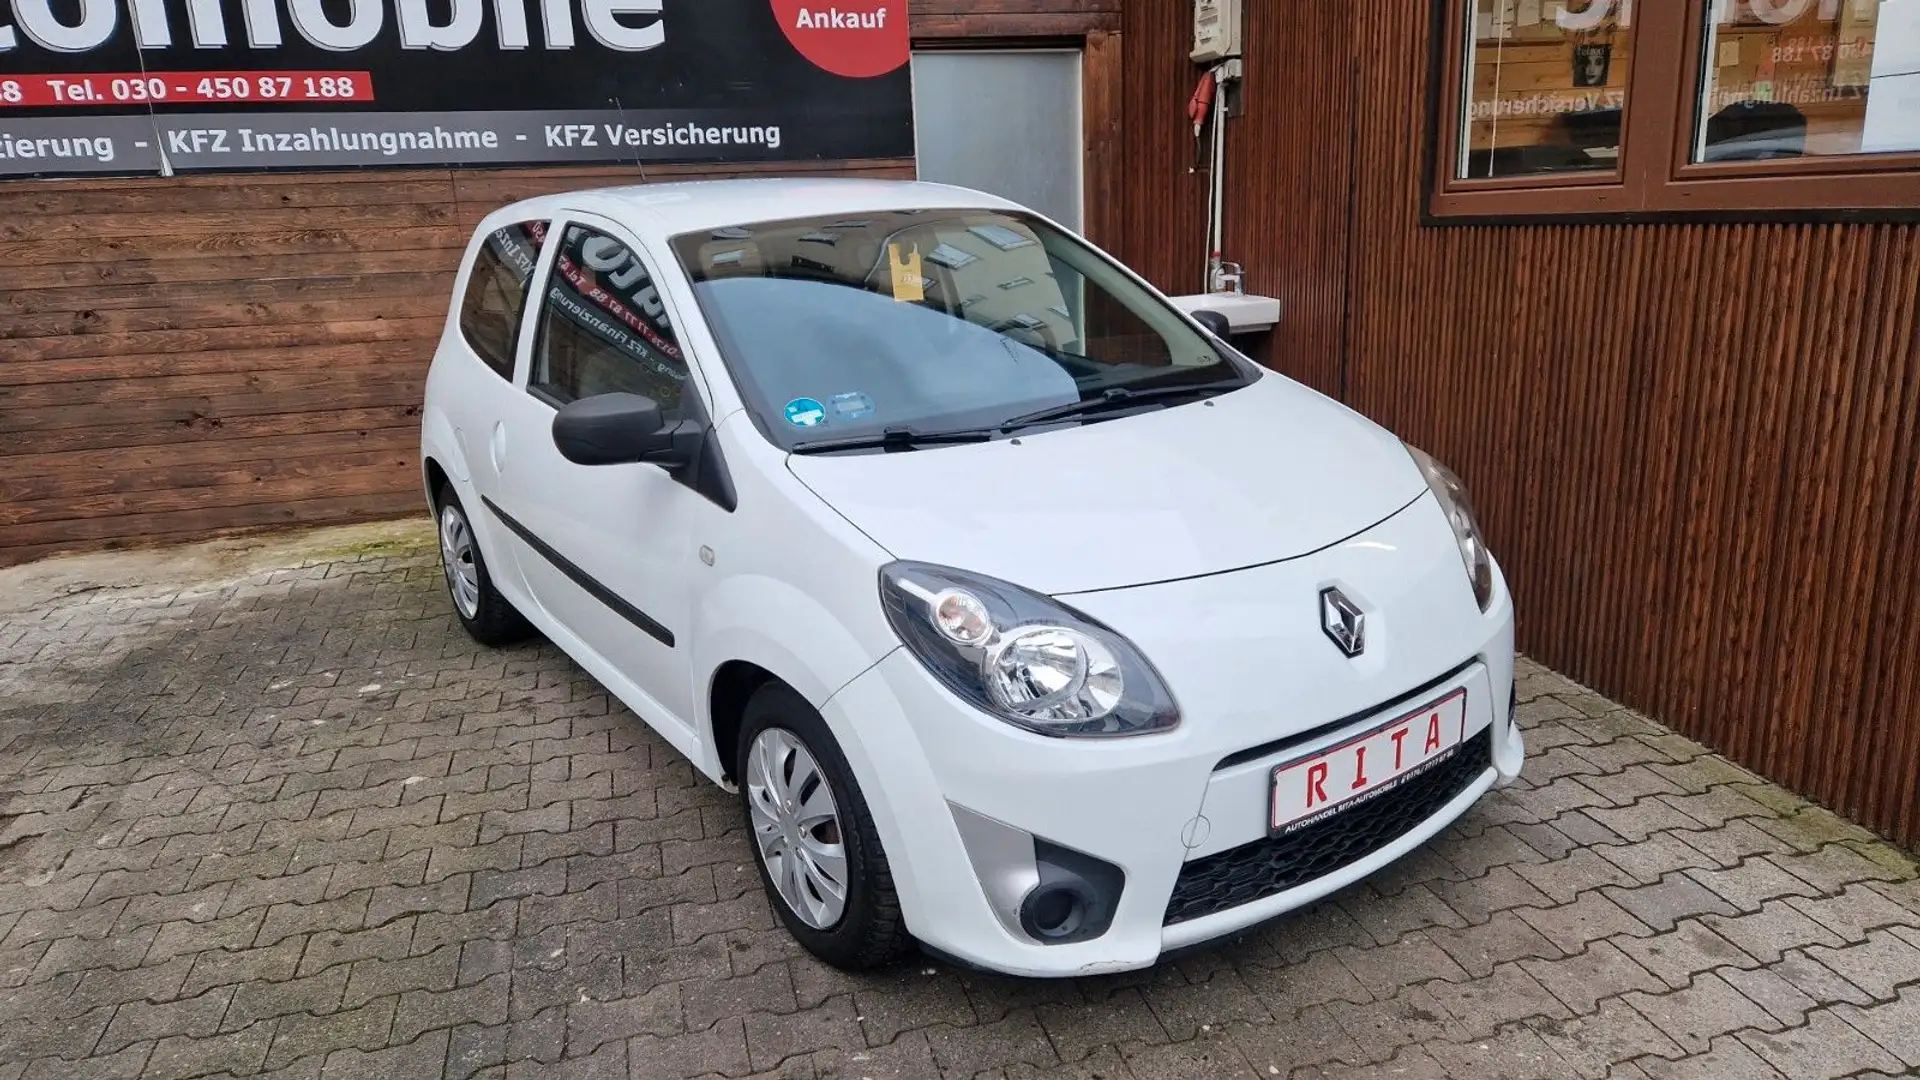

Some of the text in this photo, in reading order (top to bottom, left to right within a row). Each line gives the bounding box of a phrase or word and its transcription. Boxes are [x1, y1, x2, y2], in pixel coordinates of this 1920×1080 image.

[796, 8, 887, 29] Ankauf
[0, 80, 23, 102] 8
[46, 79, 104, 101] Tel.
[111, 78, 167, 100] 030
[196, 77, 250, 98] 450
[259, 76, 293, 97] 87
[304, 76, 355, 97] 188
[168, 129, 230, 154] KFZ
[239, 125, 498, 154] Inzahlungnahme
[545, 124, 598, 147] KFZ
[605, 122, 781, 149] Versicherung
[1285, 808, 1338, 832] AUTOHANDEL
